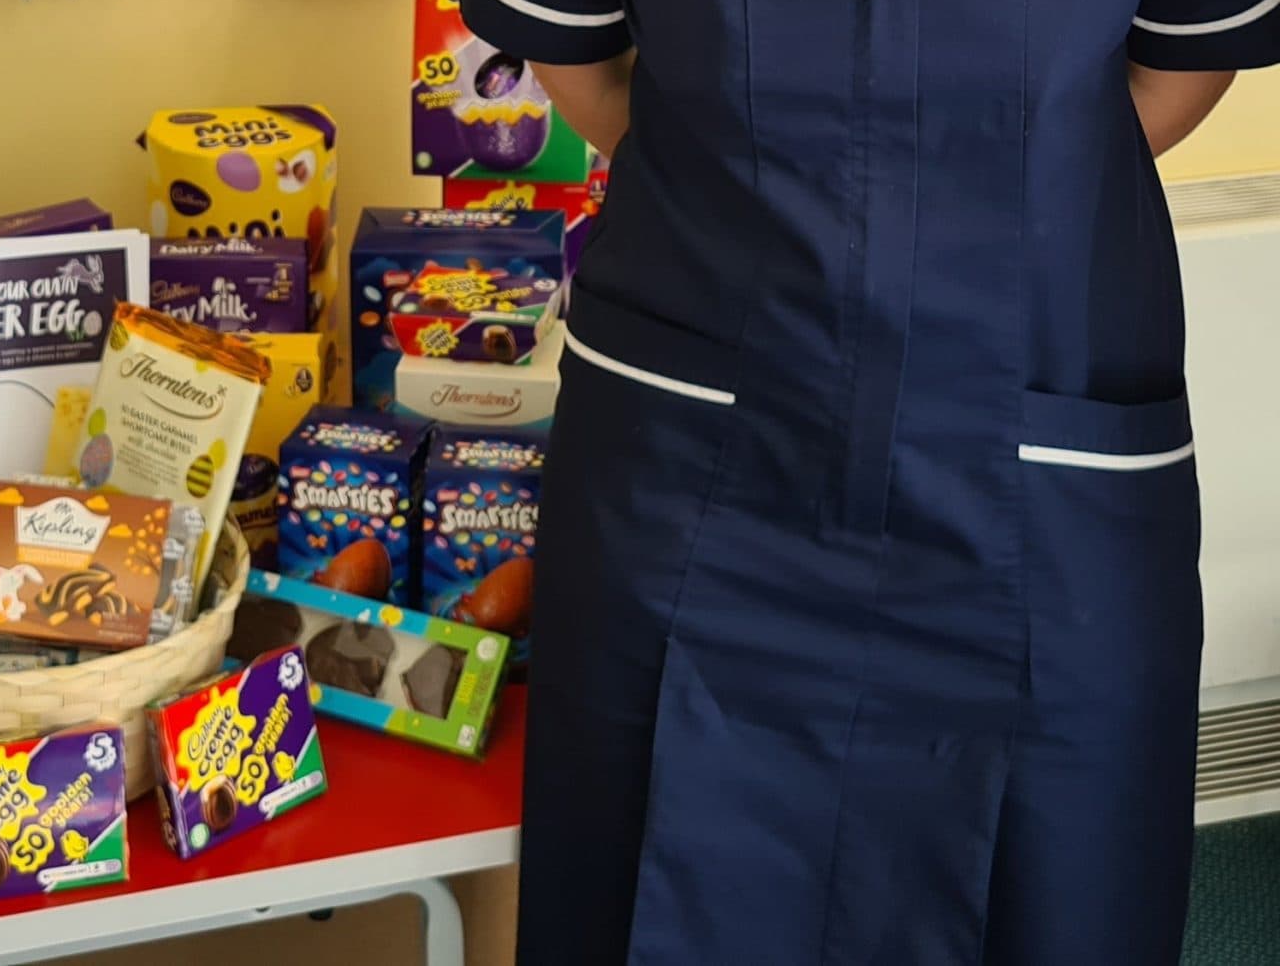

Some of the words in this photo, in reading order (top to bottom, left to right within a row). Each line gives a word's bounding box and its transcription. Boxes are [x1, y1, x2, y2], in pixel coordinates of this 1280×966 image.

[425, 56, 454, 80] 50
[196, 130, 293, 149] eggs
[159, 242, 214, 255] Dairy
[31, 275, 79, 298] OWN
[29, 298, 86, 338] EGG
[197, 295, 252, 323] Milk
[119, 352, 216, 410] Thorntons
[430, 383, 520, 411] Thorntons
[22, 511, 98, 546] Kipling
[90, 735, 108, 760] 5
[197, 704, 234, 778] creme
[215, 722, 245, 773] egg
[240, 761, 263, 799] 50
[15, 831, 47, 867] 50
